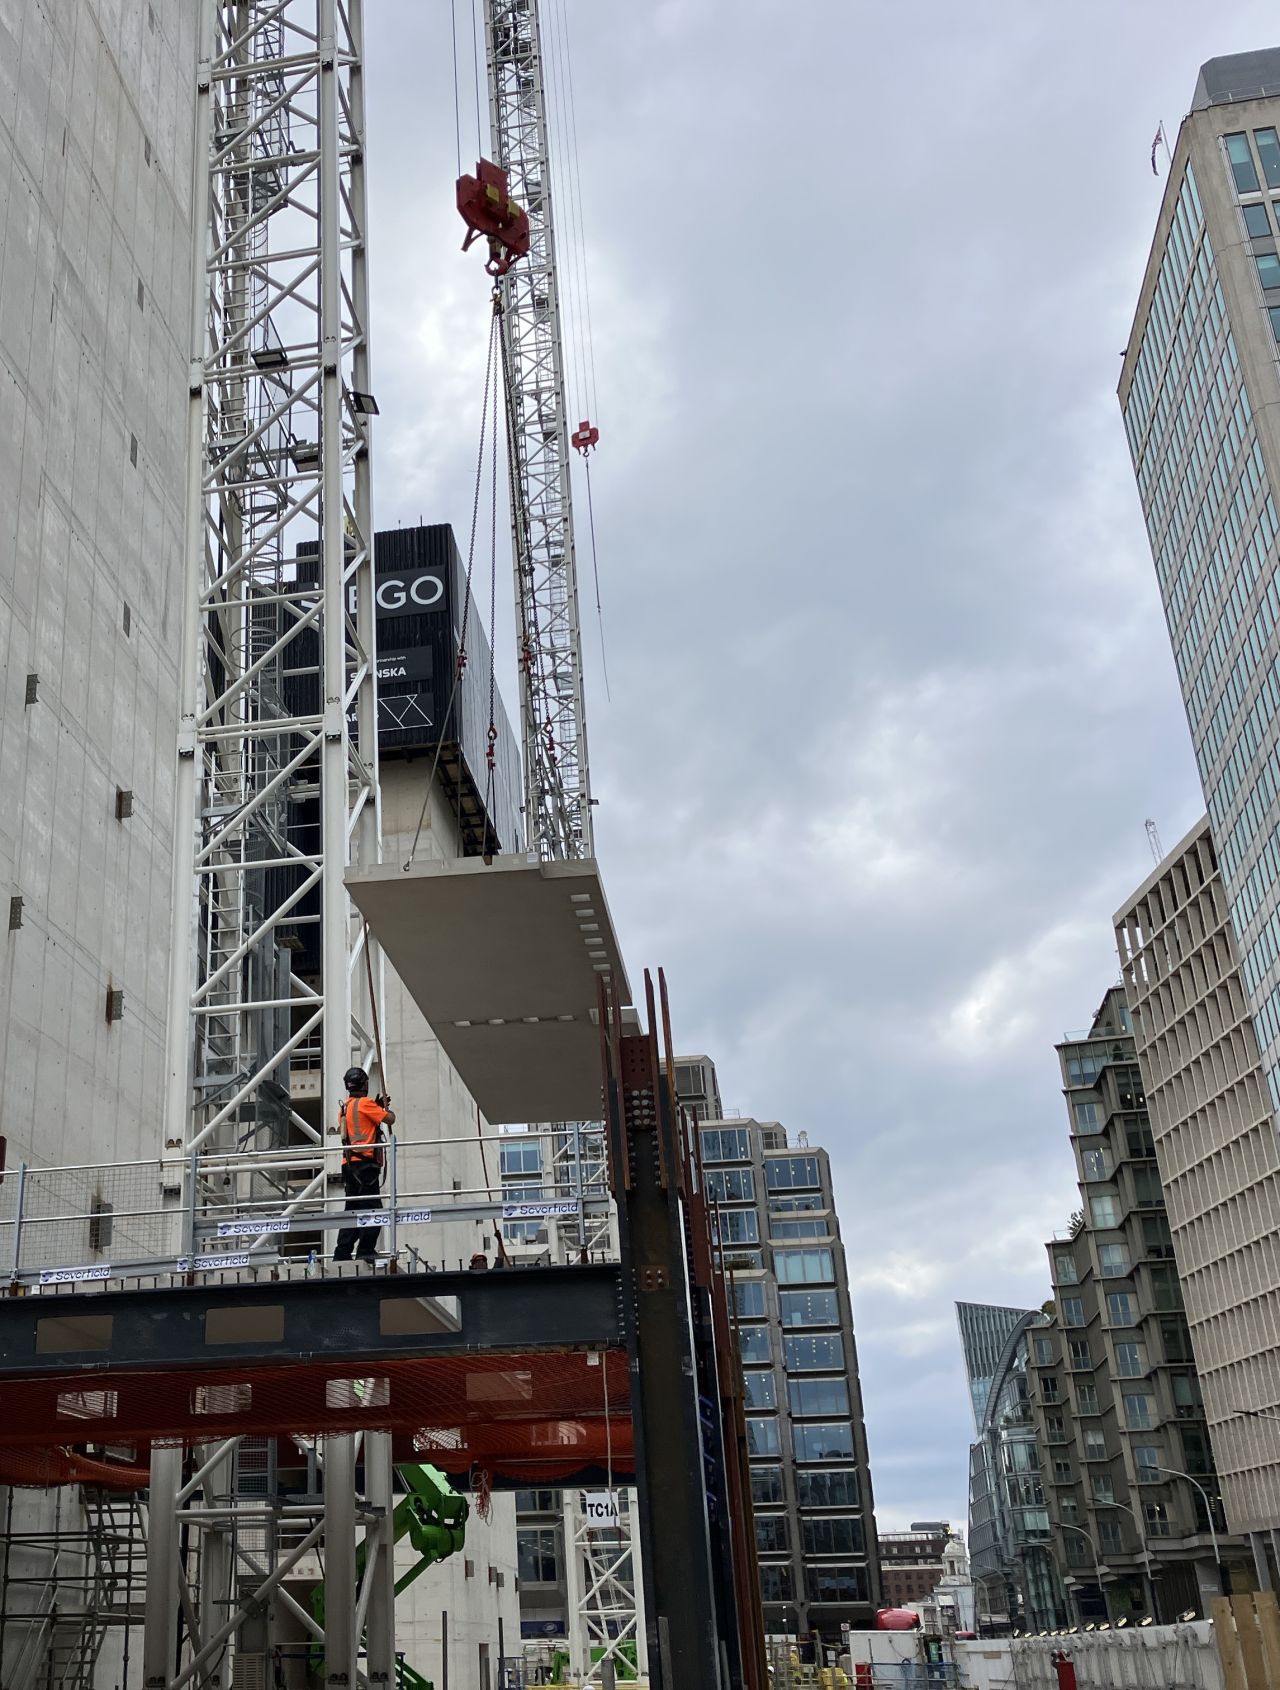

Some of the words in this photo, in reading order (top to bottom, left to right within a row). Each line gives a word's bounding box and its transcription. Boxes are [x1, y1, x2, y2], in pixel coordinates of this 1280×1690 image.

[350, 666, 407, 682] SNSKA
[520, 1202, 578, 1215] Severfield
[374, 1211, 430, 1224] Seerfield
[233, 1220, 289, 1234] Severfield
[193, 1254, 249, 1269] Severfield
[55, 1266, 110, 1281] Severfield
[588, 1502, 619, 1518] TC1A
